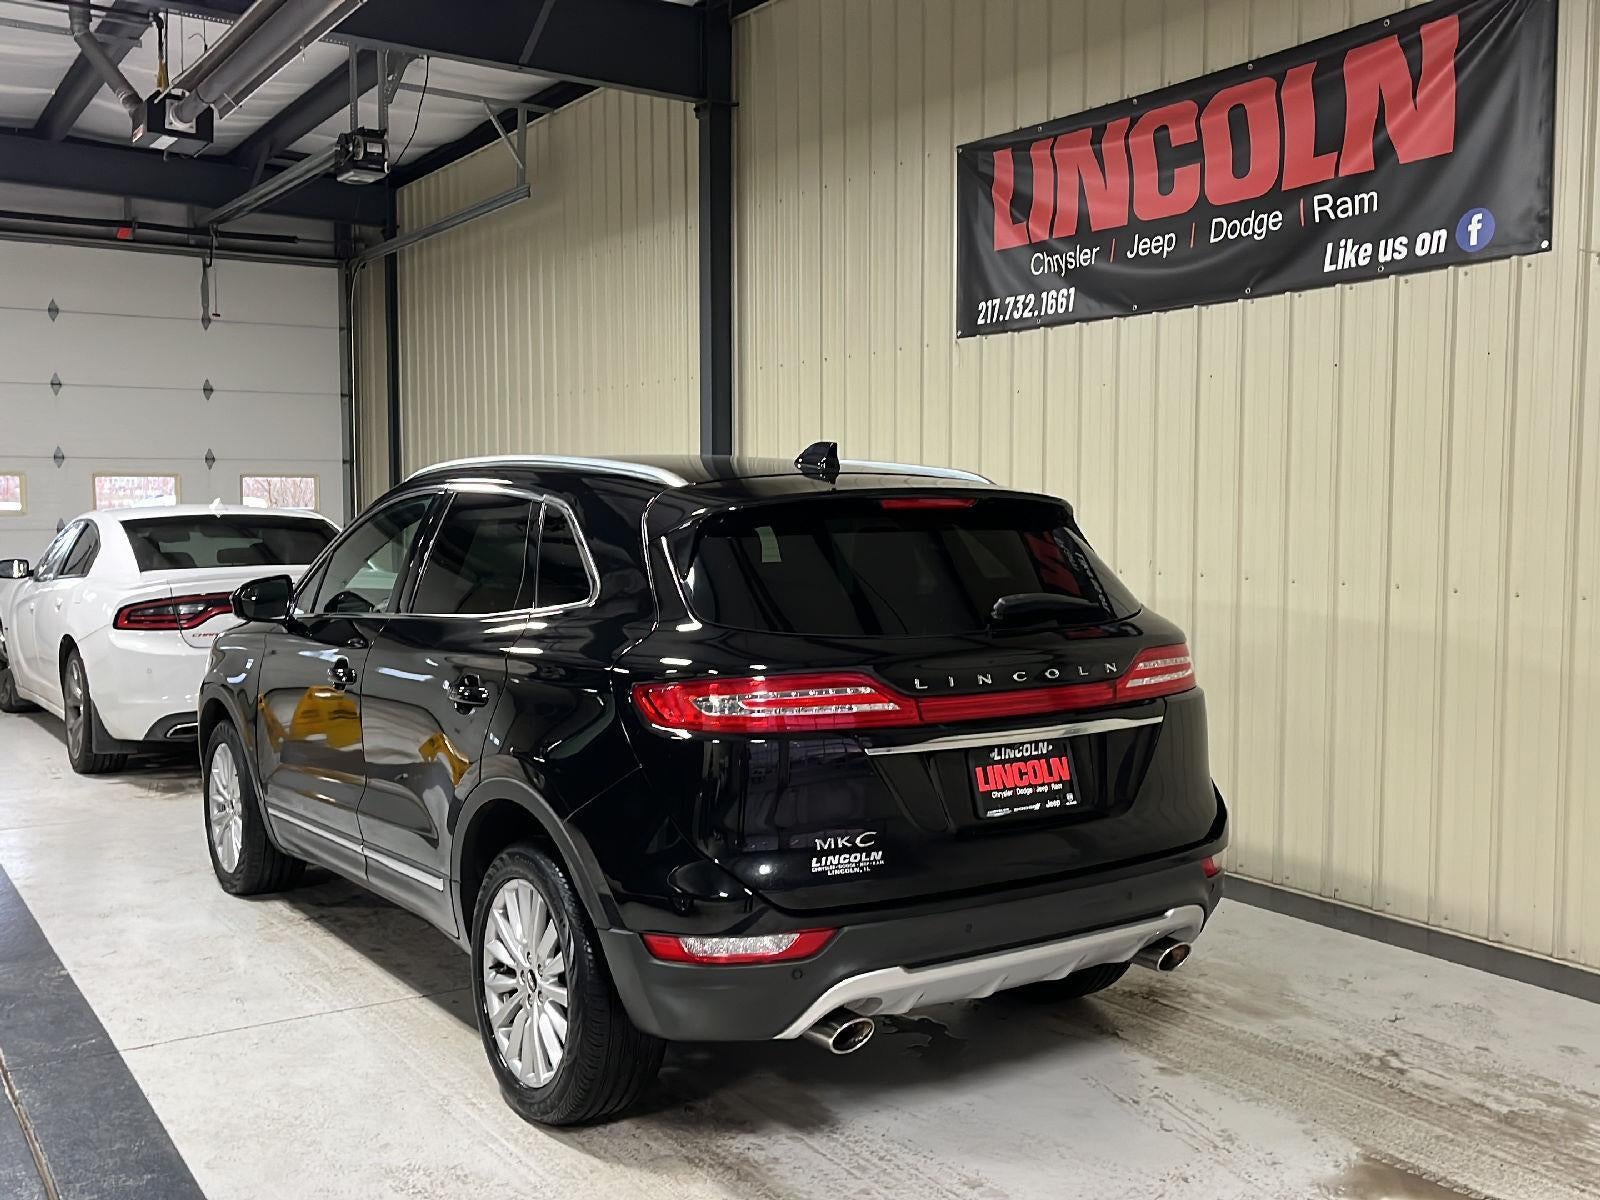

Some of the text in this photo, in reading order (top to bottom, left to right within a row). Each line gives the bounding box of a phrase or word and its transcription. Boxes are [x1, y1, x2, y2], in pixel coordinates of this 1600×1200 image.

[993, 15, 1460, 251] LINCOLN
[1030, 191, 1379, 277] Chrysler Jeep Dodge Ram
[1322, 238, 1371, 273] Like
[1378, 235, 1409, 263] us
[1414, 227, 1448, 255] on
[977, 287, 1076, 325] 217.732.1661
[914, 662, 1118, 690] LINCOLN
[993, 741, 1048, 760] LINCOLN
[975, 756, 1071, 792] LINCOLN
[991, 789, 1014, 799] Chrysler
[1045, 799, 1061, 808] Jeep
[815, 831, 877, 851] MKC
[811, 851, 883, 868] LINCOLN
